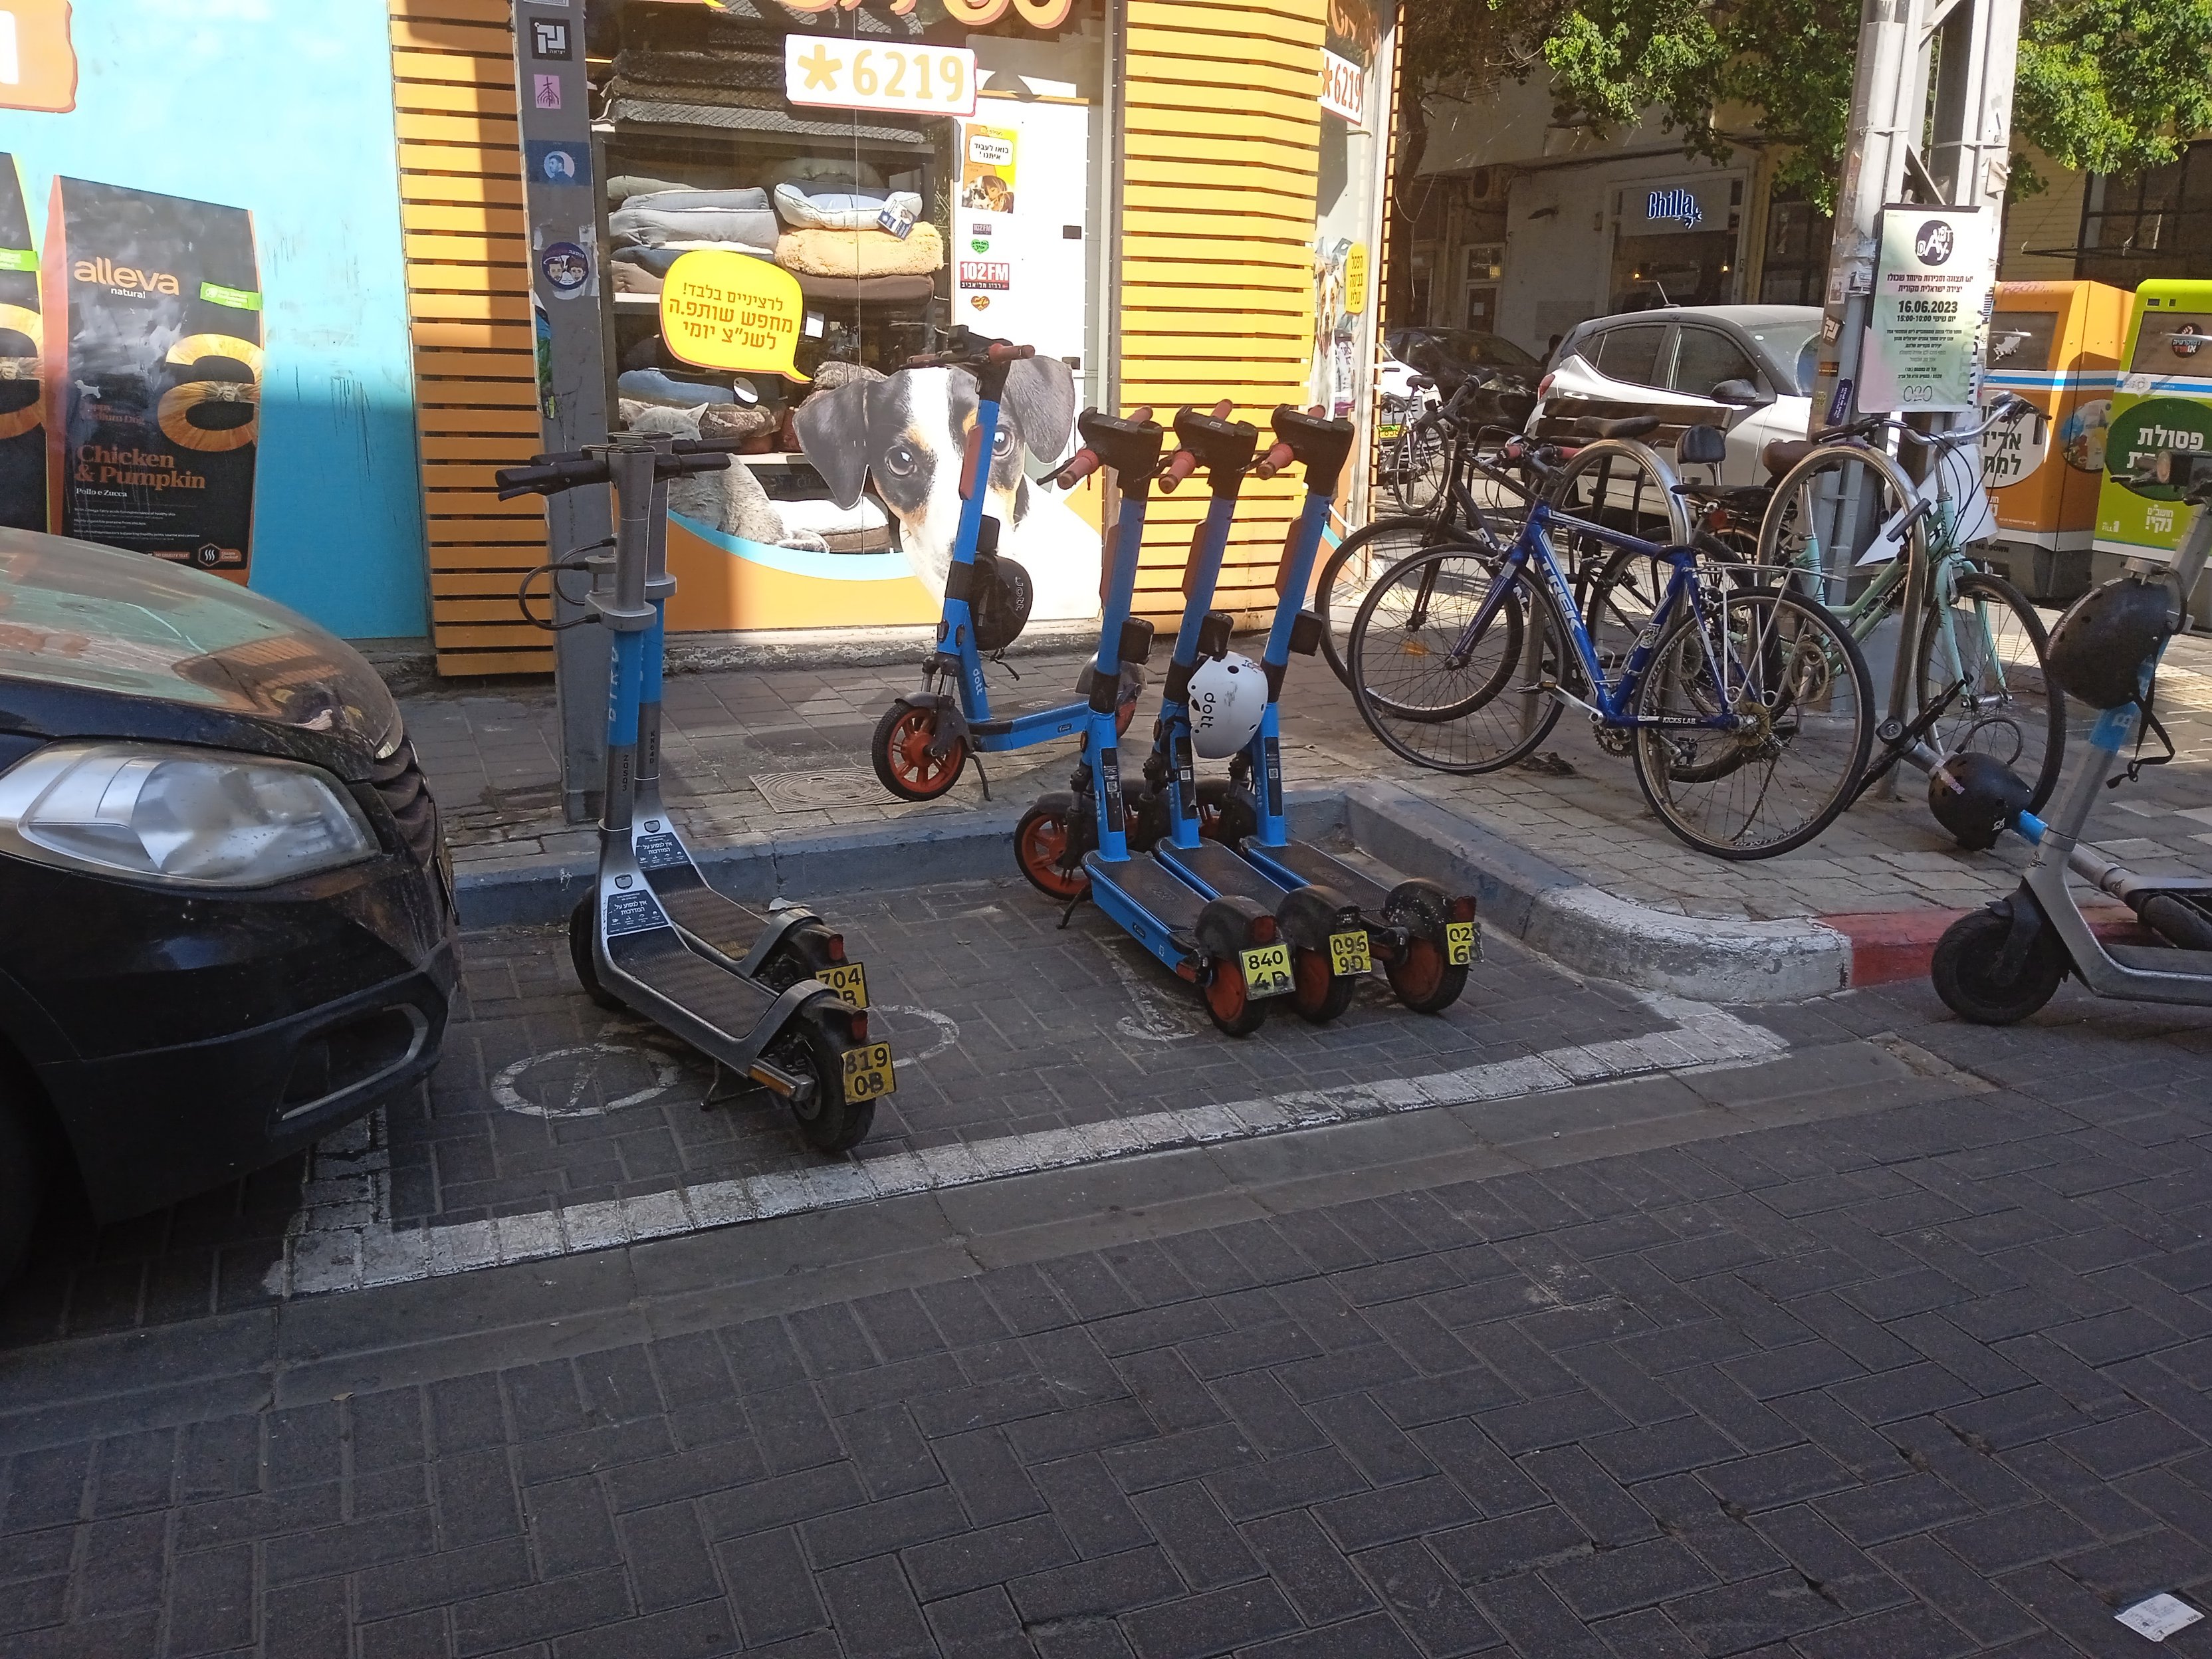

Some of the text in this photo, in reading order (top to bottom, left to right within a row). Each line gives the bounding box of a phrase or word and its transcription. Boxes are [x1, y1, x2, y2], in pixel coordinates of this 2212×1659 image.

[974, 142, 994, 152] לעבוד
[1647, 189, 1694, 219] Chilla
[74, 257, 179, 296] alleva
[961, 262, 1009, 281] 102FM
[111, 287, 146, 298] natural
[683, 282, 783, 312] לרציניים בלבד!
[669, 298, 793, 334] מחפש שותפ.ה
[1898, 300, 1958, 313] 16.06.2023
[683, 321, 715, 340] יומי
[2138, 424, 2204, 450] פסולת
[77, 444, 174, 468] Chicken
[75, 464, 205, 491] & Pumpkin
[1542, 556, 1583, 632] TREK
[973, 668, 982, 695] dott
[1200, 693, 1216, 728] dott
[621, 907, 645, 915] המדרכות
[1449, 927, 1474, 942] 02
[1333, 938, 1367, 956] 096
[1248, 950, 1283, 970] 840
[819, 968, 861, 989] 704
[845, 1047, 887, 1075] 819
